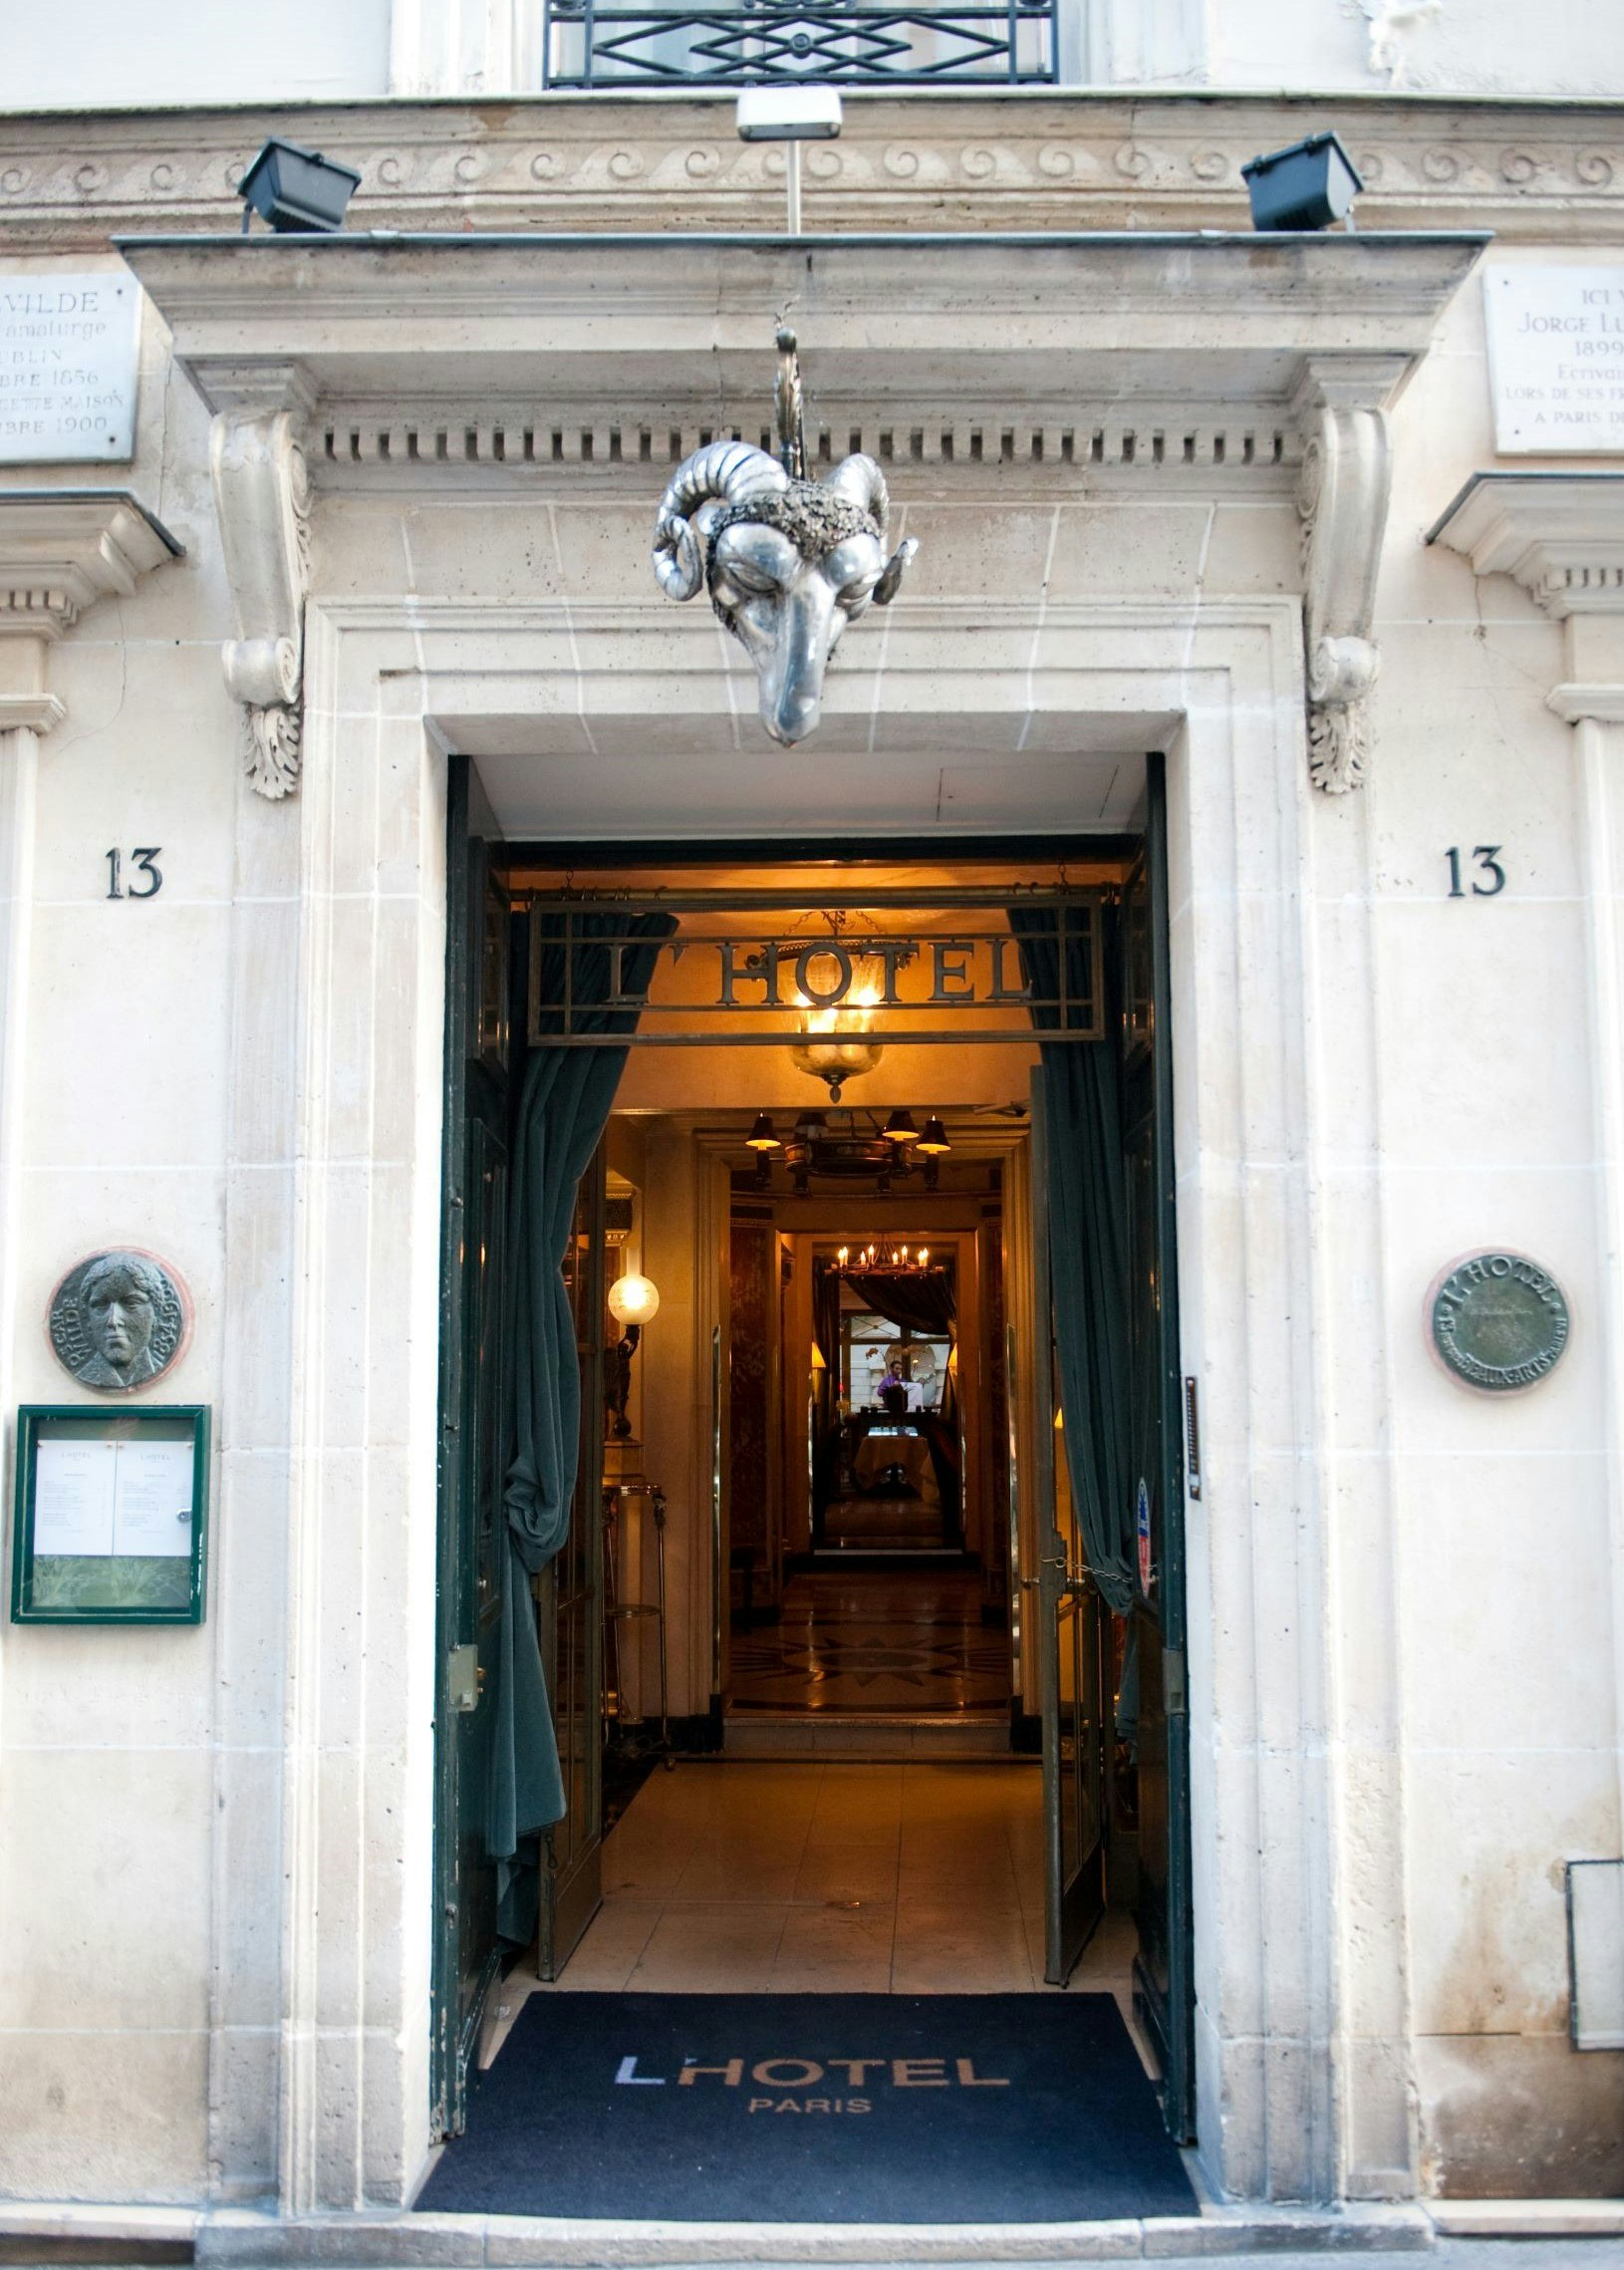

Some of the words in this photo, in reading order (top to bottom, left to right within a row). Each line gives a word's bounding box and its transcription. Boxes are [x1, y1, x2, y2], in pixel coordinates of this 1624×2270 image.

[1582, 289, 1610, 305] ICI
[1517, 312, 1589, 333] JORGE
[1576, 340, 1624, 357] 1899
[1552, 387, 1570, 400] DE
[56, 417, 107, 433] 1900
[1554, 411, 1601, 424] PARIS
[105, 847, 162, 899] 13
[1444, 845, 1505, 897] 13
[747, 2097, 872, 2114] PARIS
